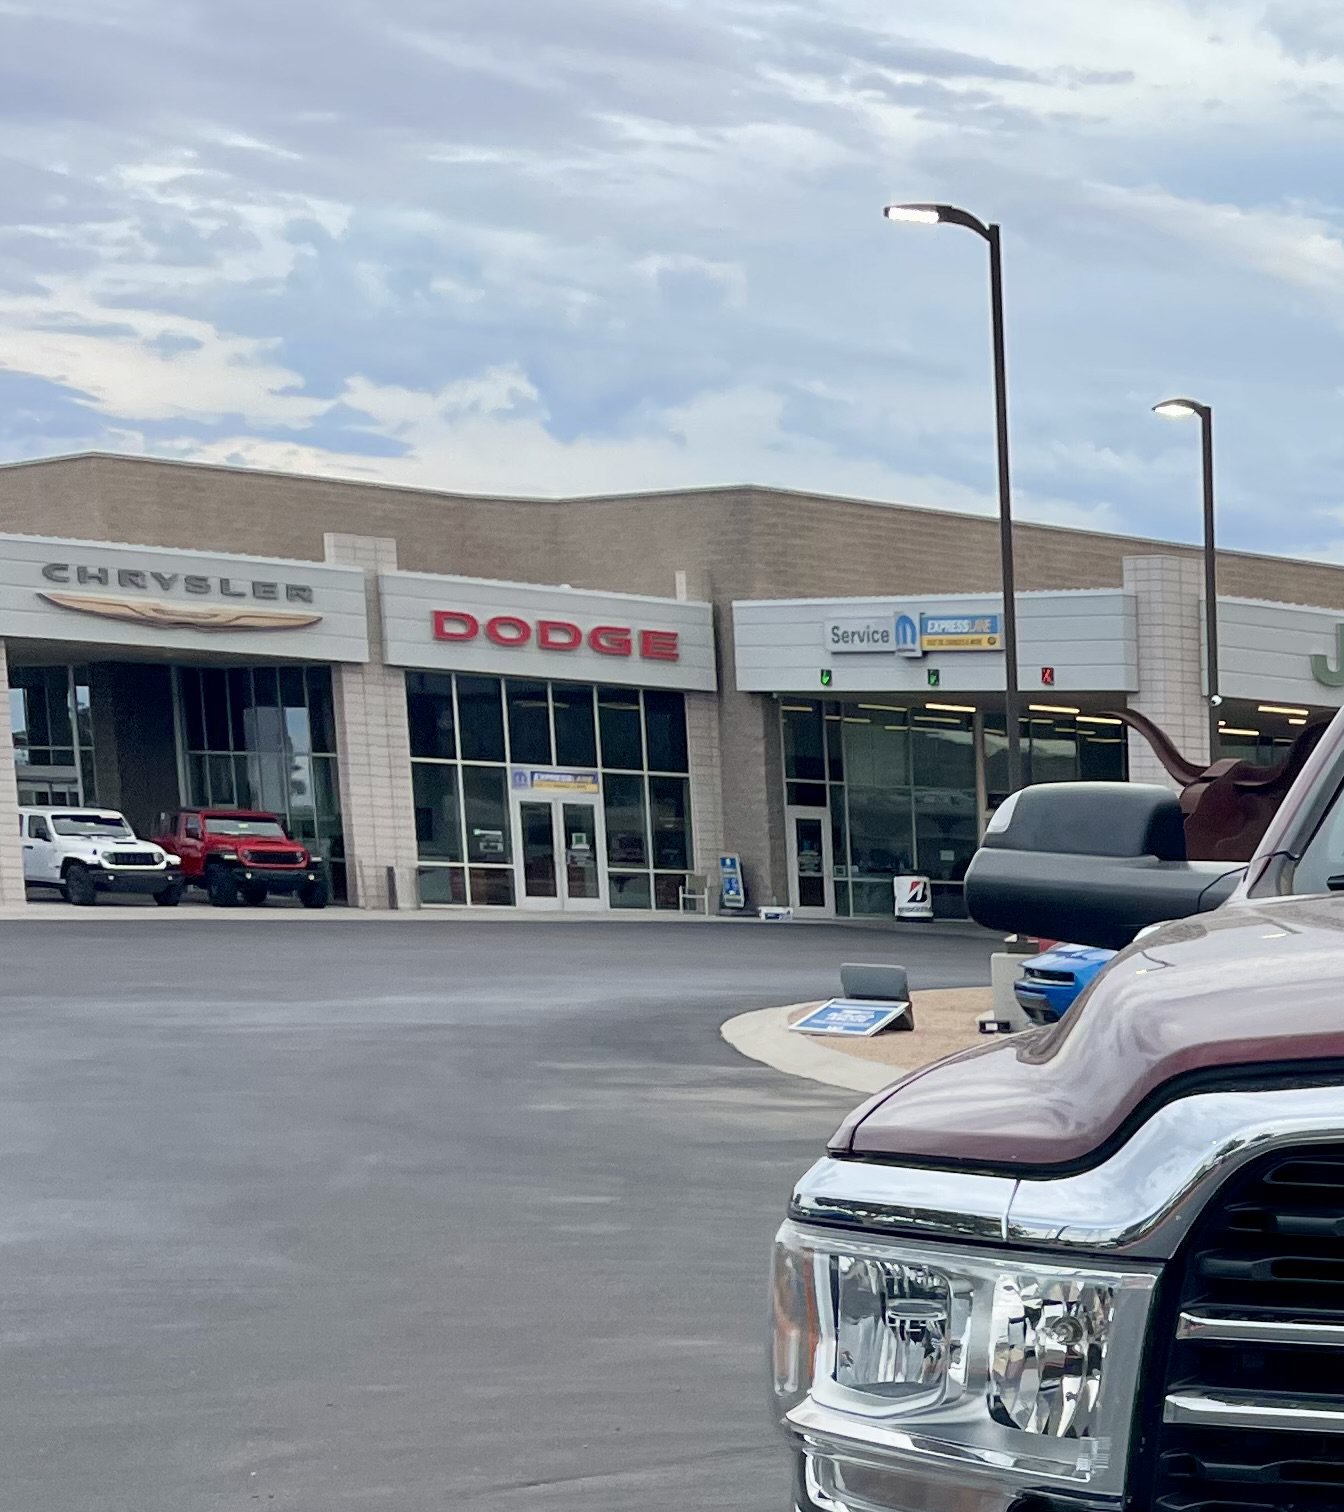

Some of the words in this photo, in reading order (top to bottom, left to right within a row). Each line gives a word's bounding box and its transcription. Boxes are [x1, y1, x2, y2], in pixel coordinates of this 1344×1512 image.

[41, 562, 313, 603] CHRYSLER
[431, 609, 680, 663] DODGE
[831, 625, 890, 644] Service
